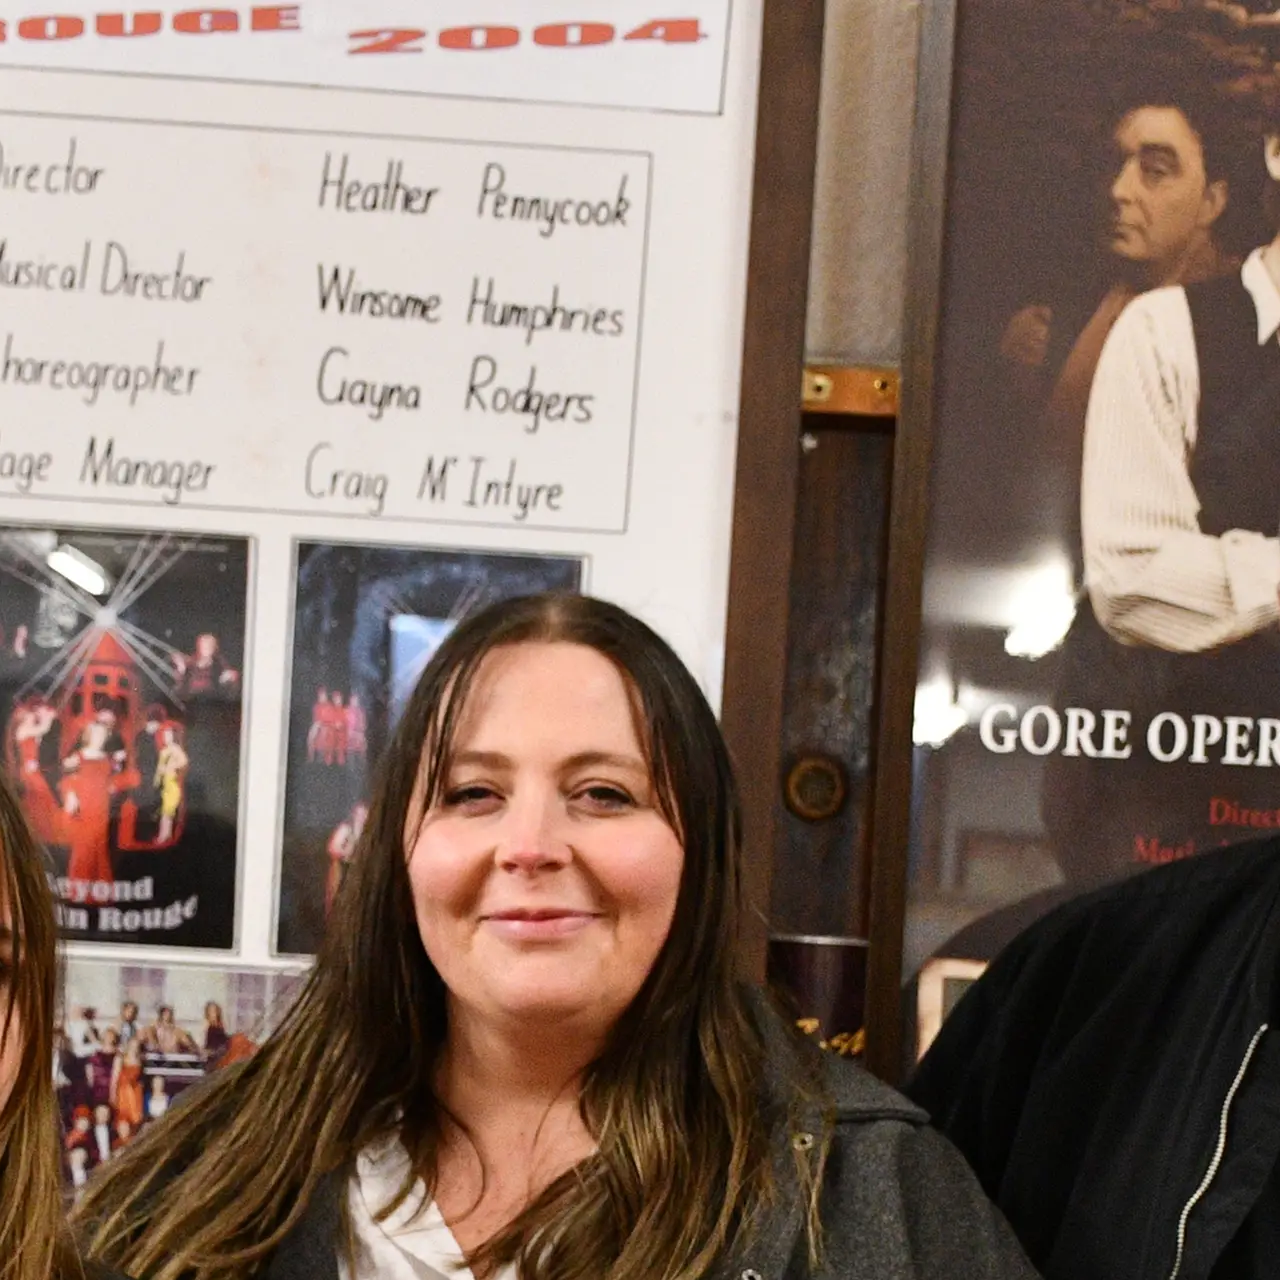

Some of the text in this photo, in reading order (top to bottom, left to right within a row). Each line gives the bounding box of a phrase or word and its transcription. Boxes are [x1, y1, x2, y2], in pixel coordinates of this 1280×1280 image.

[347, 18, 708, 55] 2004
[318, 151, 631, 238] Heather Pennycook
[100, 241, 212, 302] Director
[317, 263, 624, 345] Winsome Humphries
[317, 346, 595, 434] Gayna Rodgers
[79, 435, 216, 505] Manager
[305, 442, 388, 517] Craig
[980, 703, 1132, 758] GORE
[99, 894, 198, 932] Rouge
